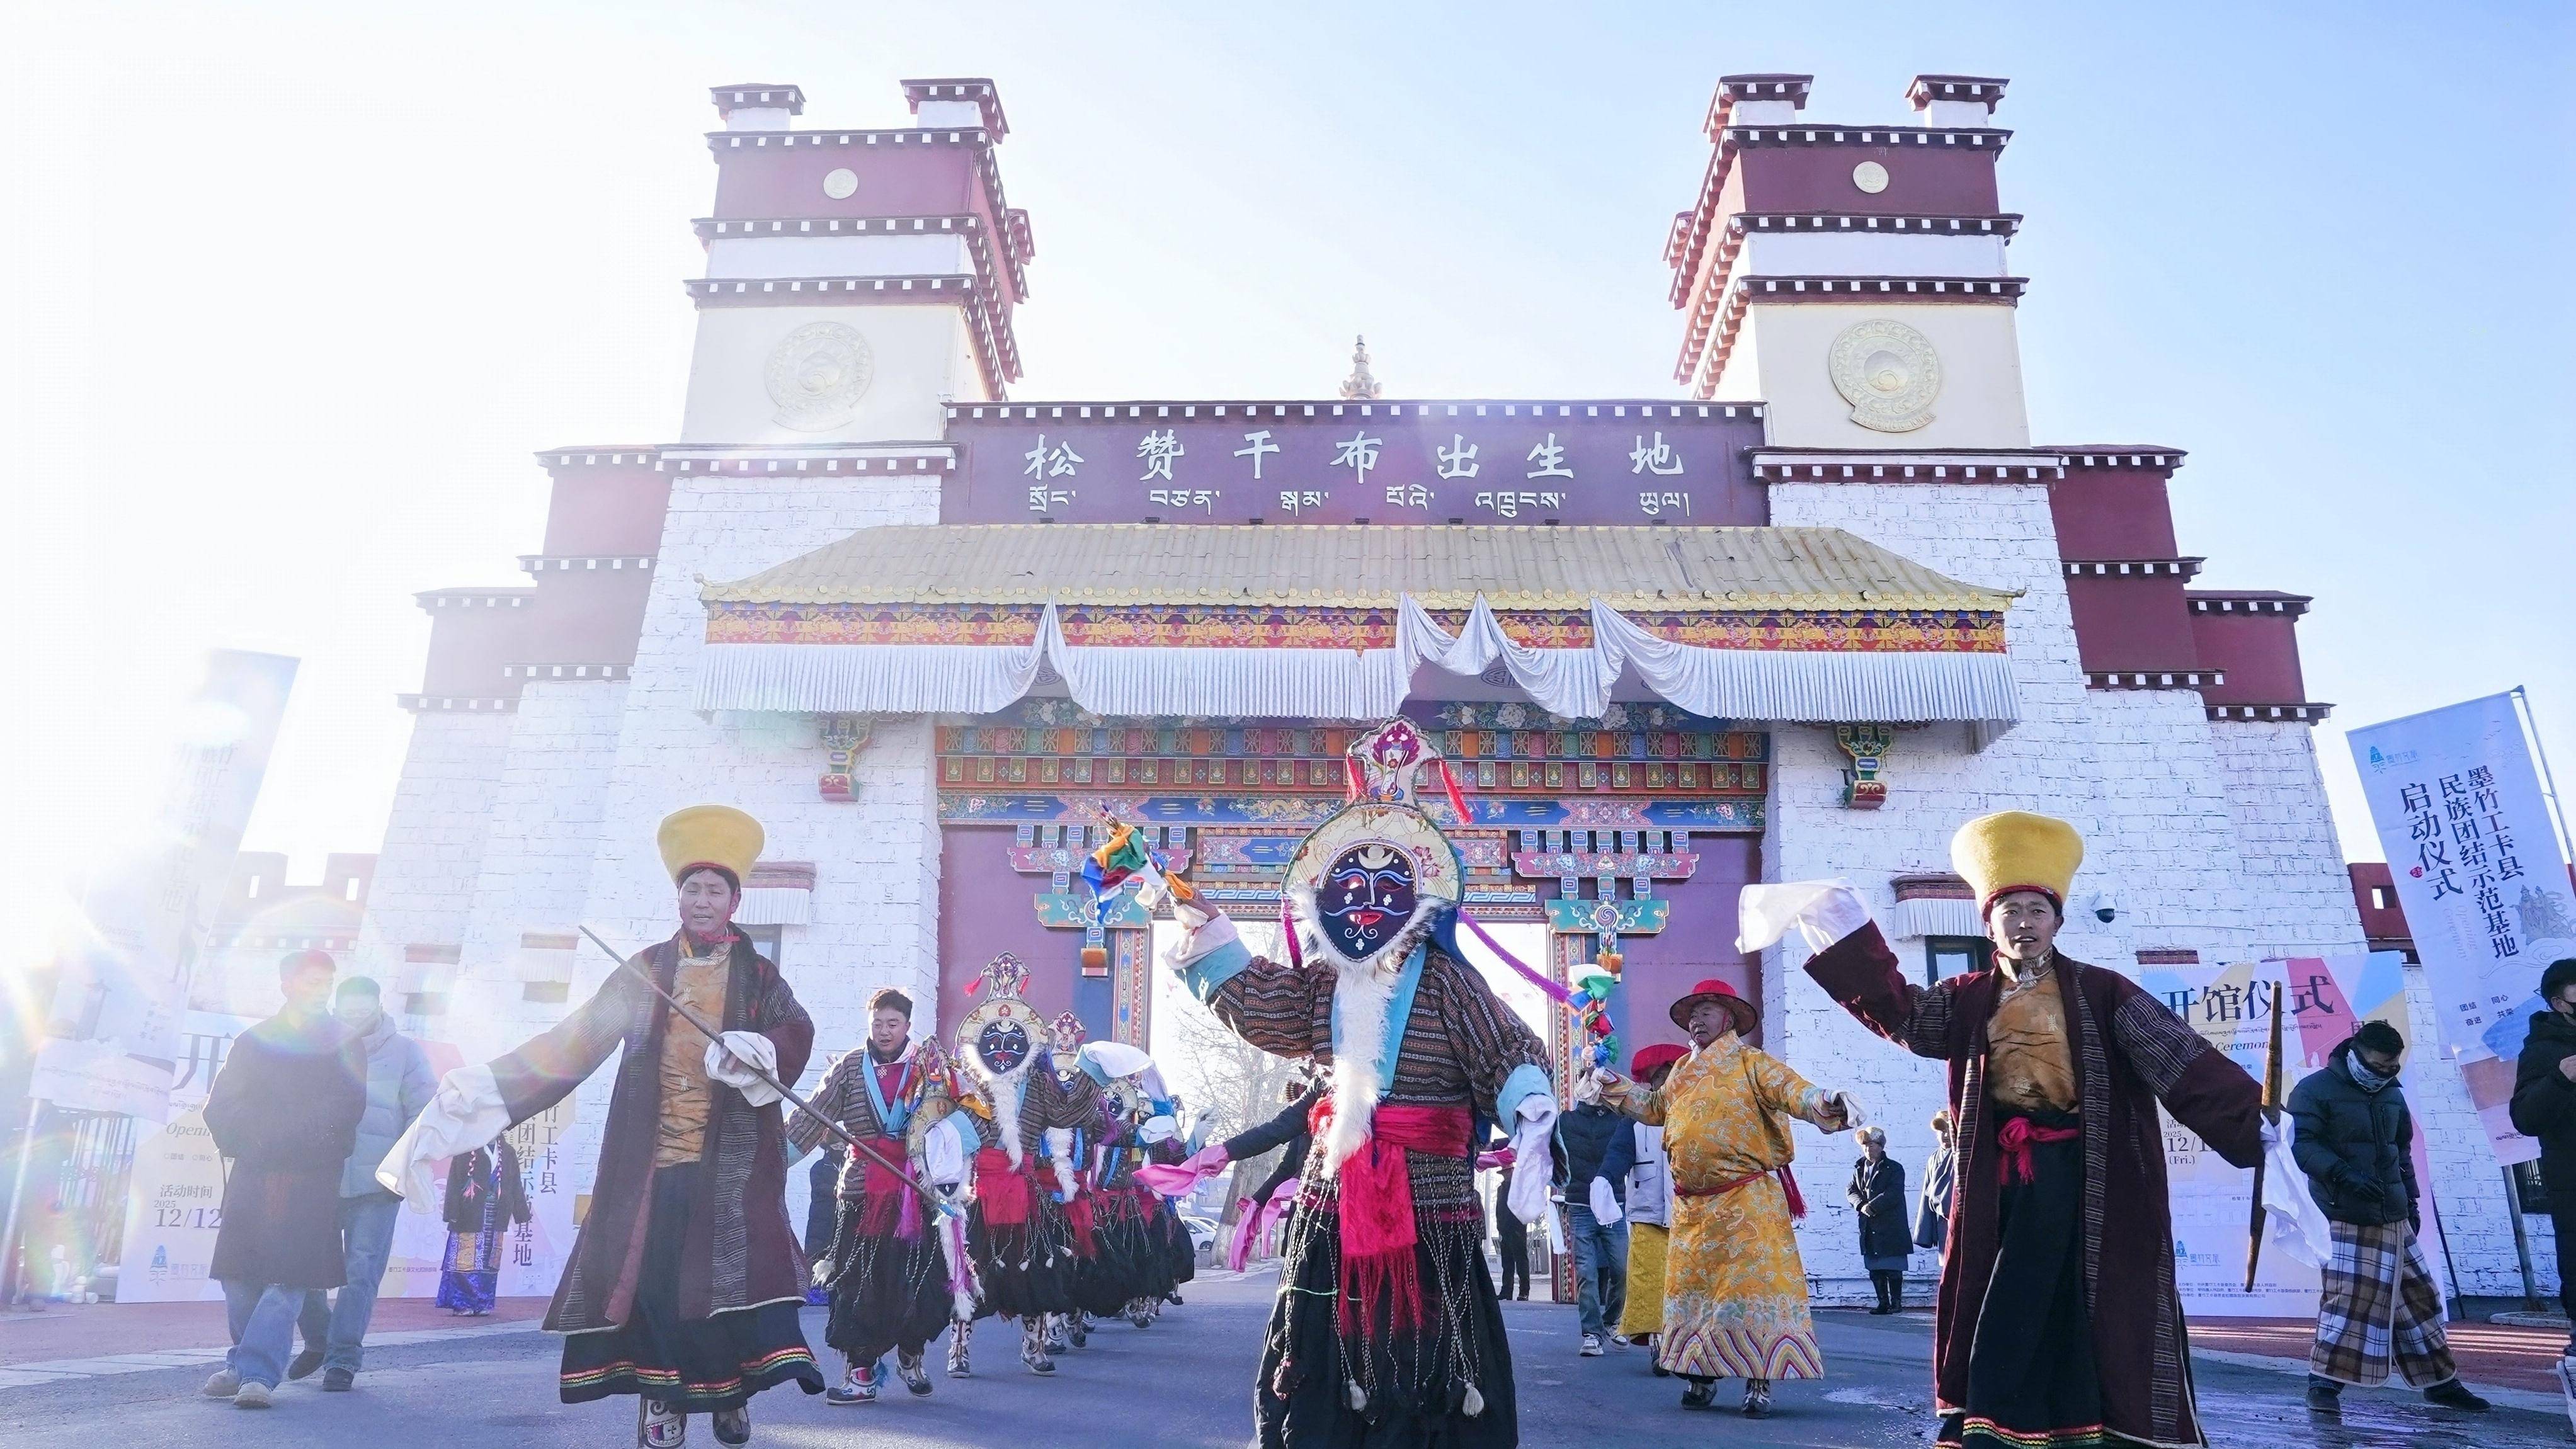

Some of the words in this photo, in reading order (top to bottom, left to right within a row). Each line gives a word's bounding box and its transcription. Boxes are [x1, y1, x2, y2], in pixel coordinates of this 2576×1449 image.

[1023, 429, 1684, 482] 松赞干布出生地
[2468, 764, 2524, 881] 墨竹工卡县
[2400, 783, 2464, 901] 启动仪式
[2439, 774, 2519, 959] 民族团结示范基地
[2459, 1001, 2477, 1013] 团结
[2491, 994, 2509, 1005] 同心
[2465, 1016, 2483, 1026] 奋进
[2496, 1008, 2514, 1018] 共荣
[2216, 1041, 2269, 1052] Ceremon
[2167, 1137, 2214, 1152] 12/1
[2170, 1155, 2195, 1165] (Fri.)
[159, 1184, 213, 1199] 活动时间
[154, 1200, 176, 1208] 2025
[154, 1208, 222, 1229] 12/12
